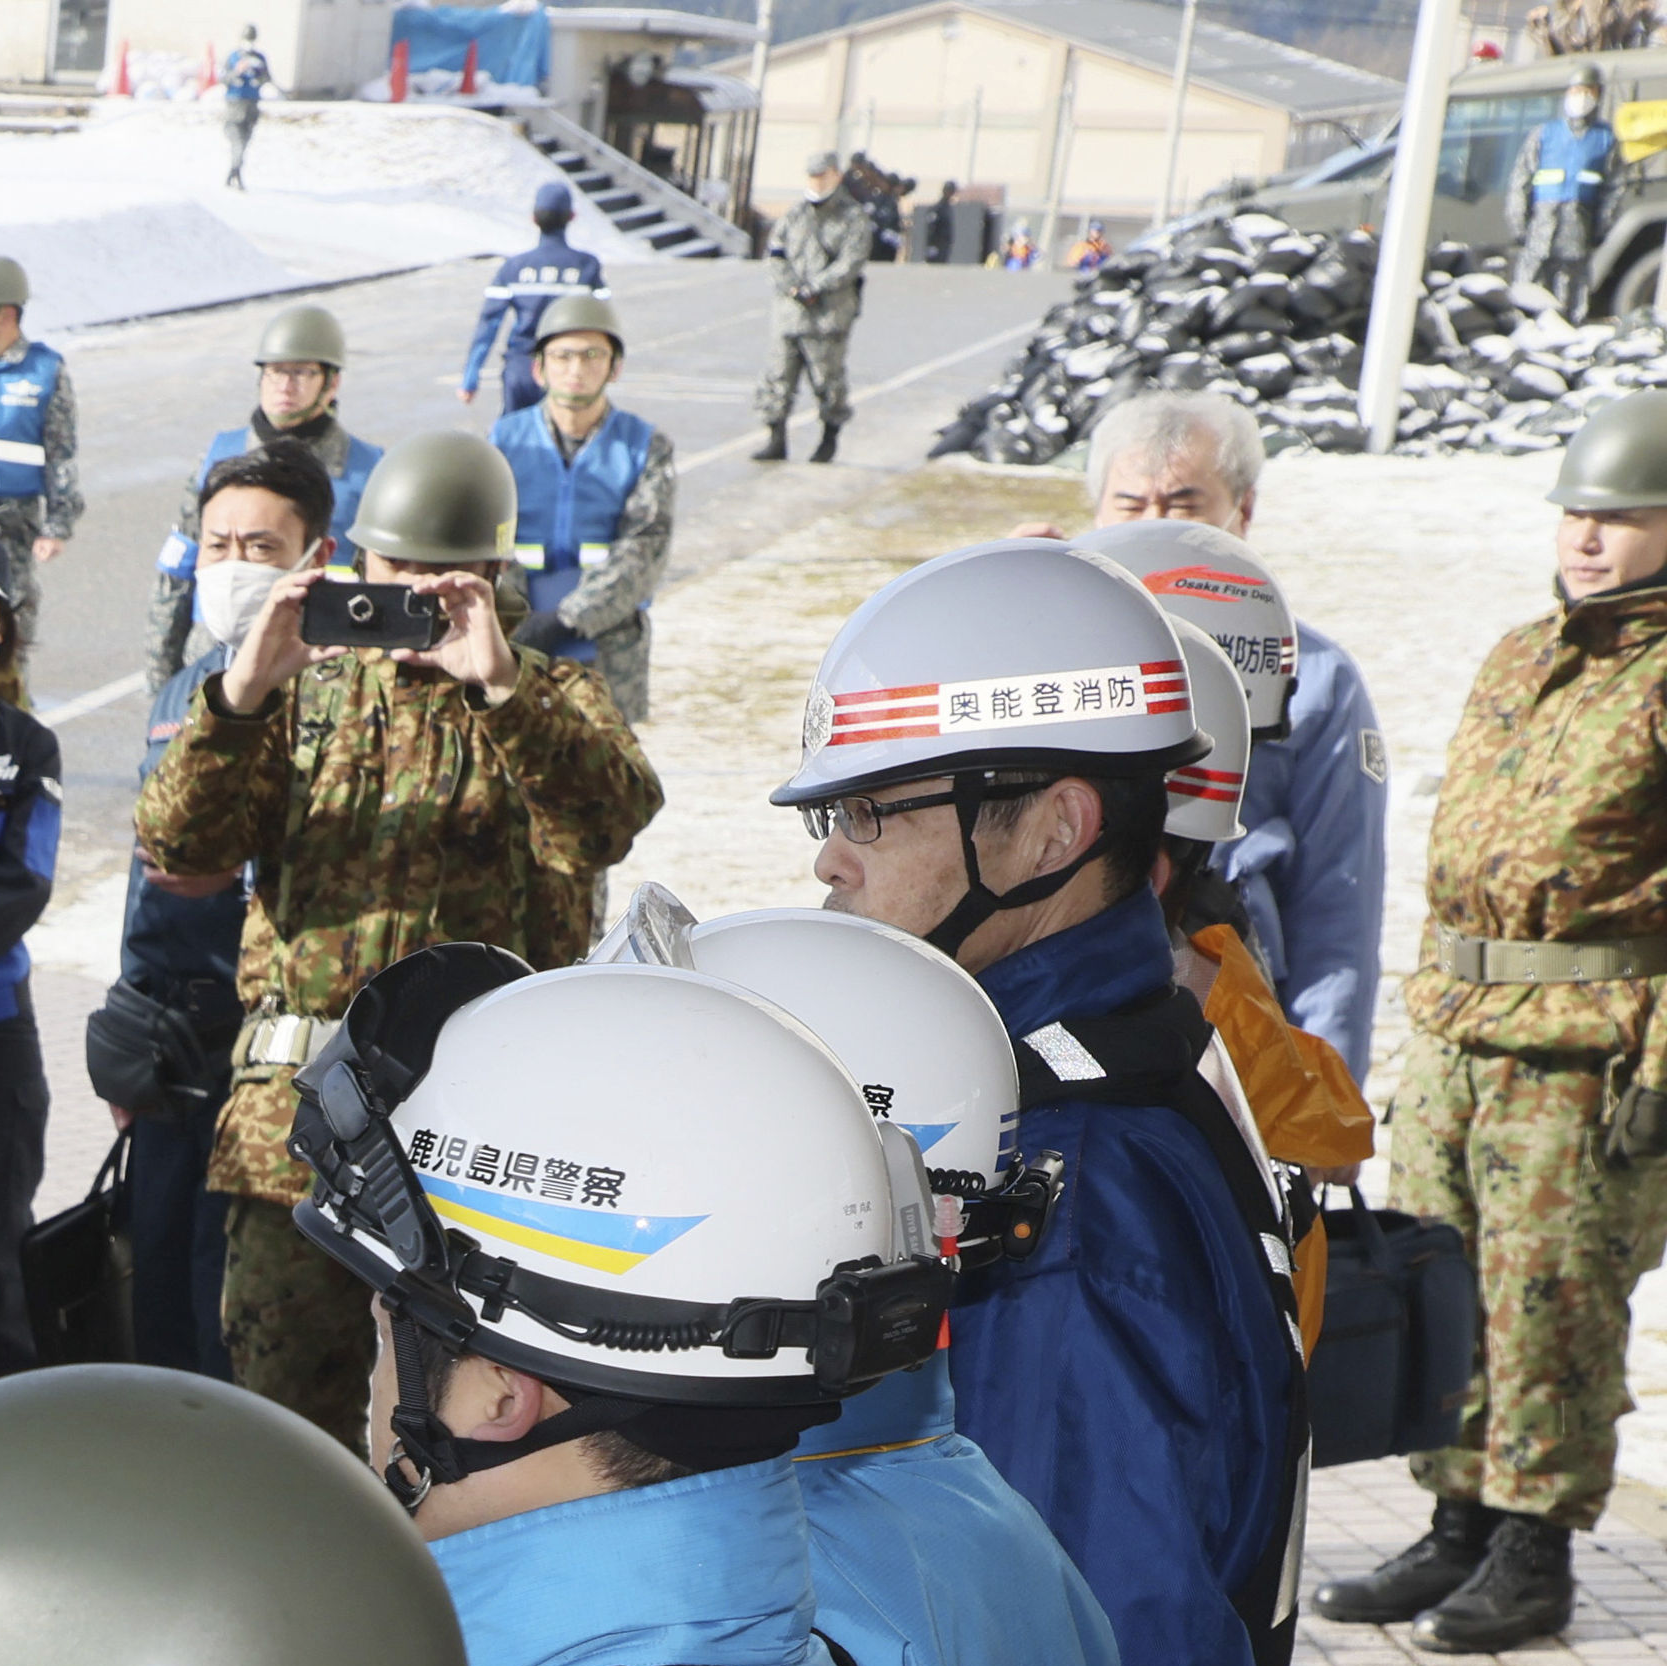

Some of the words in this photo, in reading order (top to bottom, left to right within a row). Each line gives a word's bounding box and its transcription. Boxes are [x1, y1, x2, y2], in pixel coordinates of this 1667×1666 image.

[1174, 578, 1220, 593] Osaka
[1223, 584, 1249, 597] Fire
[948, 675, 1137, 725] 奥能登消防
[407, 1128, 626, 1209] 鹿児島県警察
